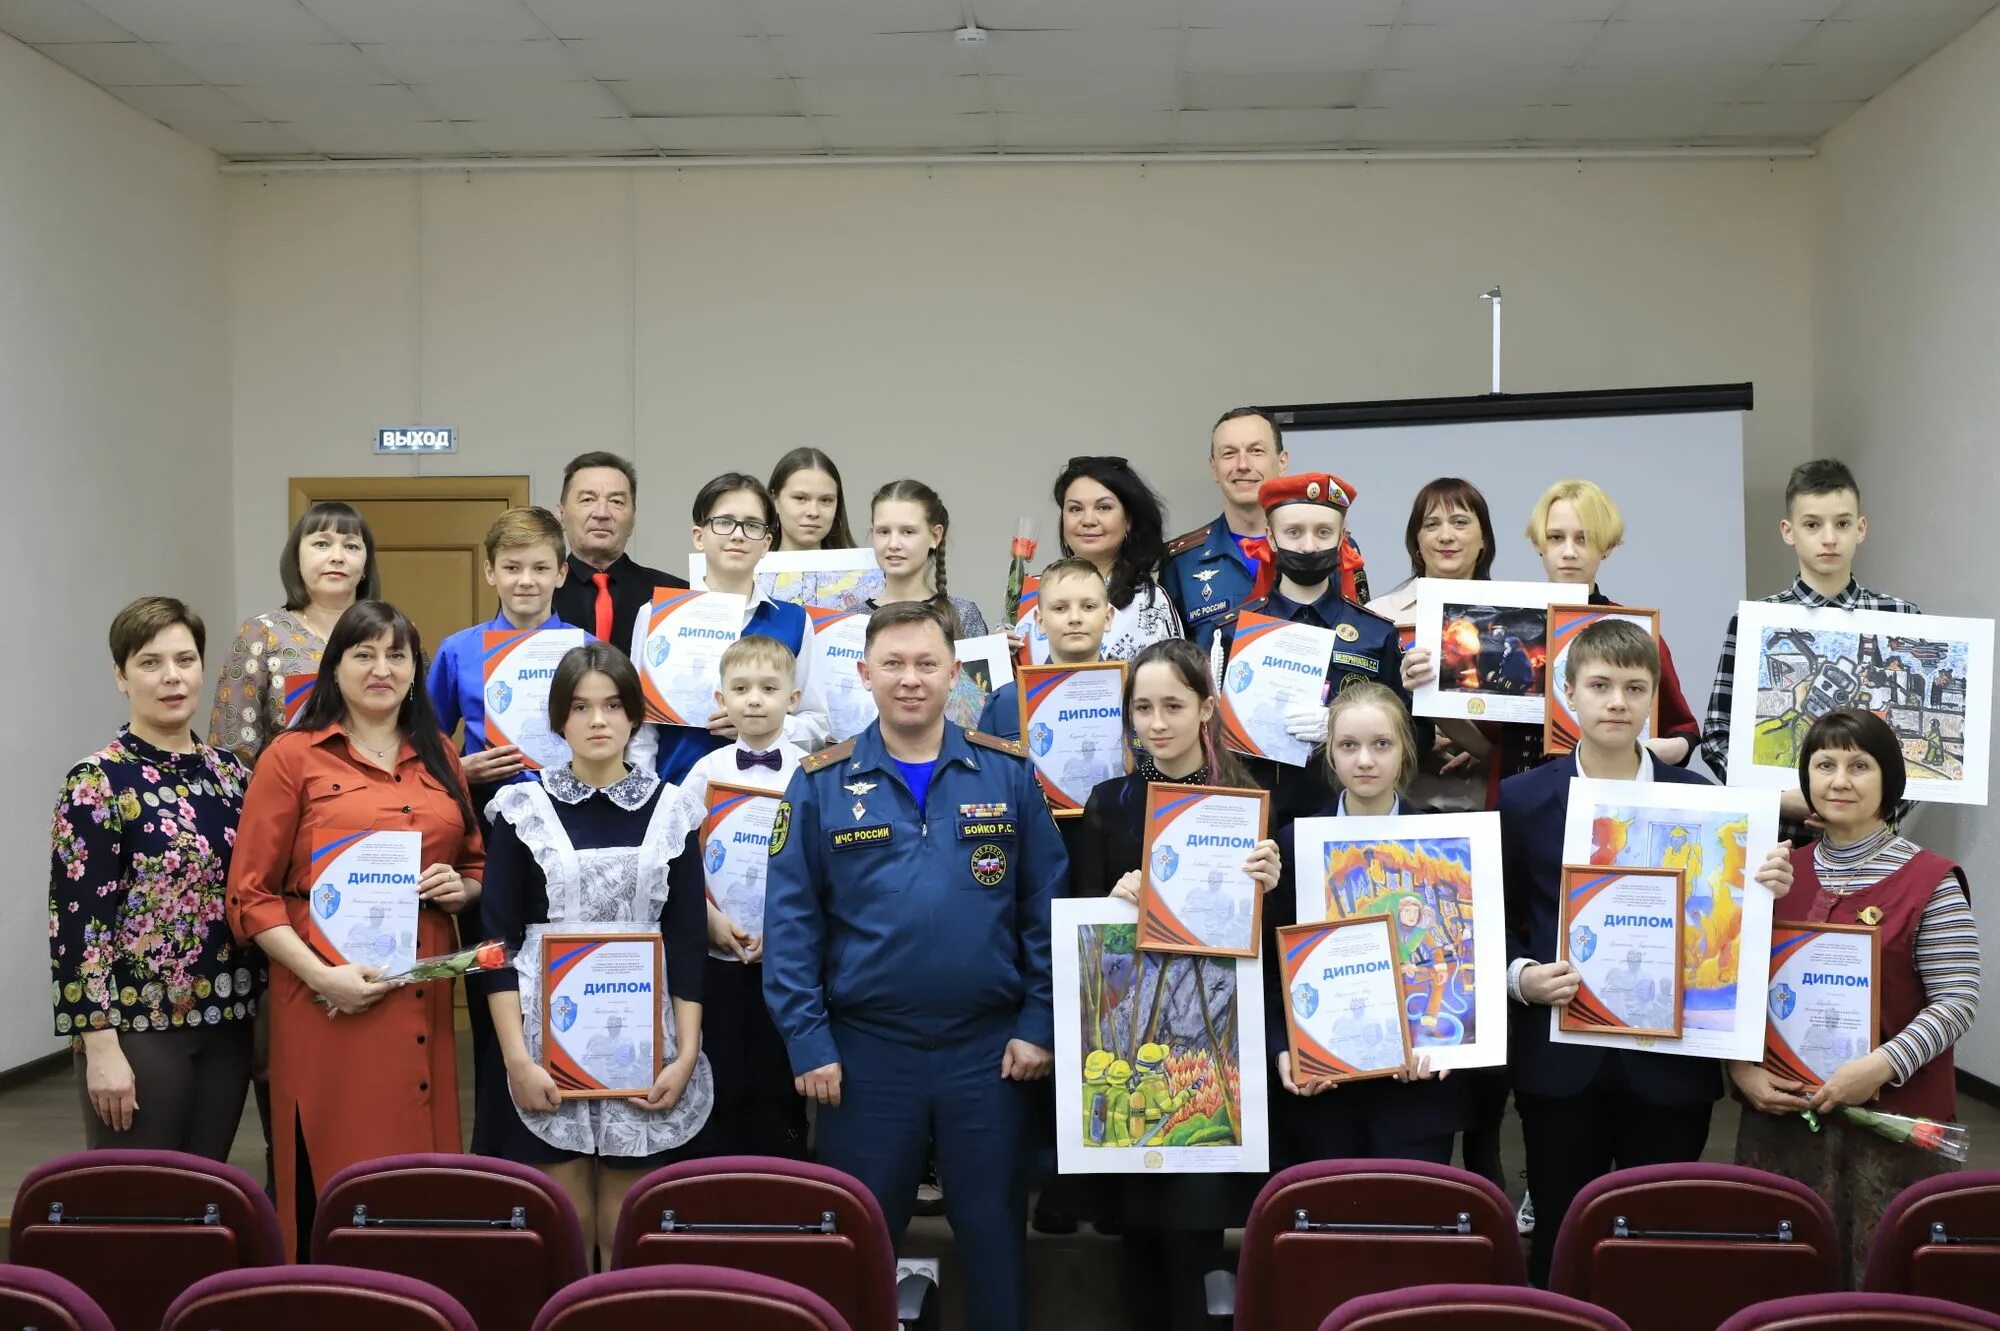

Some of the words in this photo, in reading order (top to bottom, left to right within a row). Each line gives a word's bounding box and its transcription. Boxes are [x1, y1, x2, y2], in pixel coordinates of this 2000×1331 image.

[383, 431, 449, 447] ВЫХОД
[1202, 601, 1226, 615] РОССИИ
[678, 627, 736, 640] ДИПЛОМ
[827, 646, 864, 659] ДИПЛ
[1262, 655, 1323, 677] ДИПЛОМ
[518, 669, 559, 681] ДИПЛ
[1058, 707, 1121, 721] ДИПЛОМ
[835, 831, 852, 844] МЧС
[854, 827, 889, 840] РОССИИ
[964, 824, 996, 835] БОЙКО
[998, 823, 1015, 834] Р.С.
[733, 831, 772, 846] ДИПЛ
[1186, 834, 1255, 849] ДИПЛОМ
[348, 872, 416, 885] ДИПЛОМ
[1604, 914, 1673, 928] ДИПЛОМ
[1323, 960, 1390, 980] ДИПЛОМ
[1802, 973, 1869, 987] ДИПЛОМ
[584, 982, 651, 996] ДИПЛОМ
